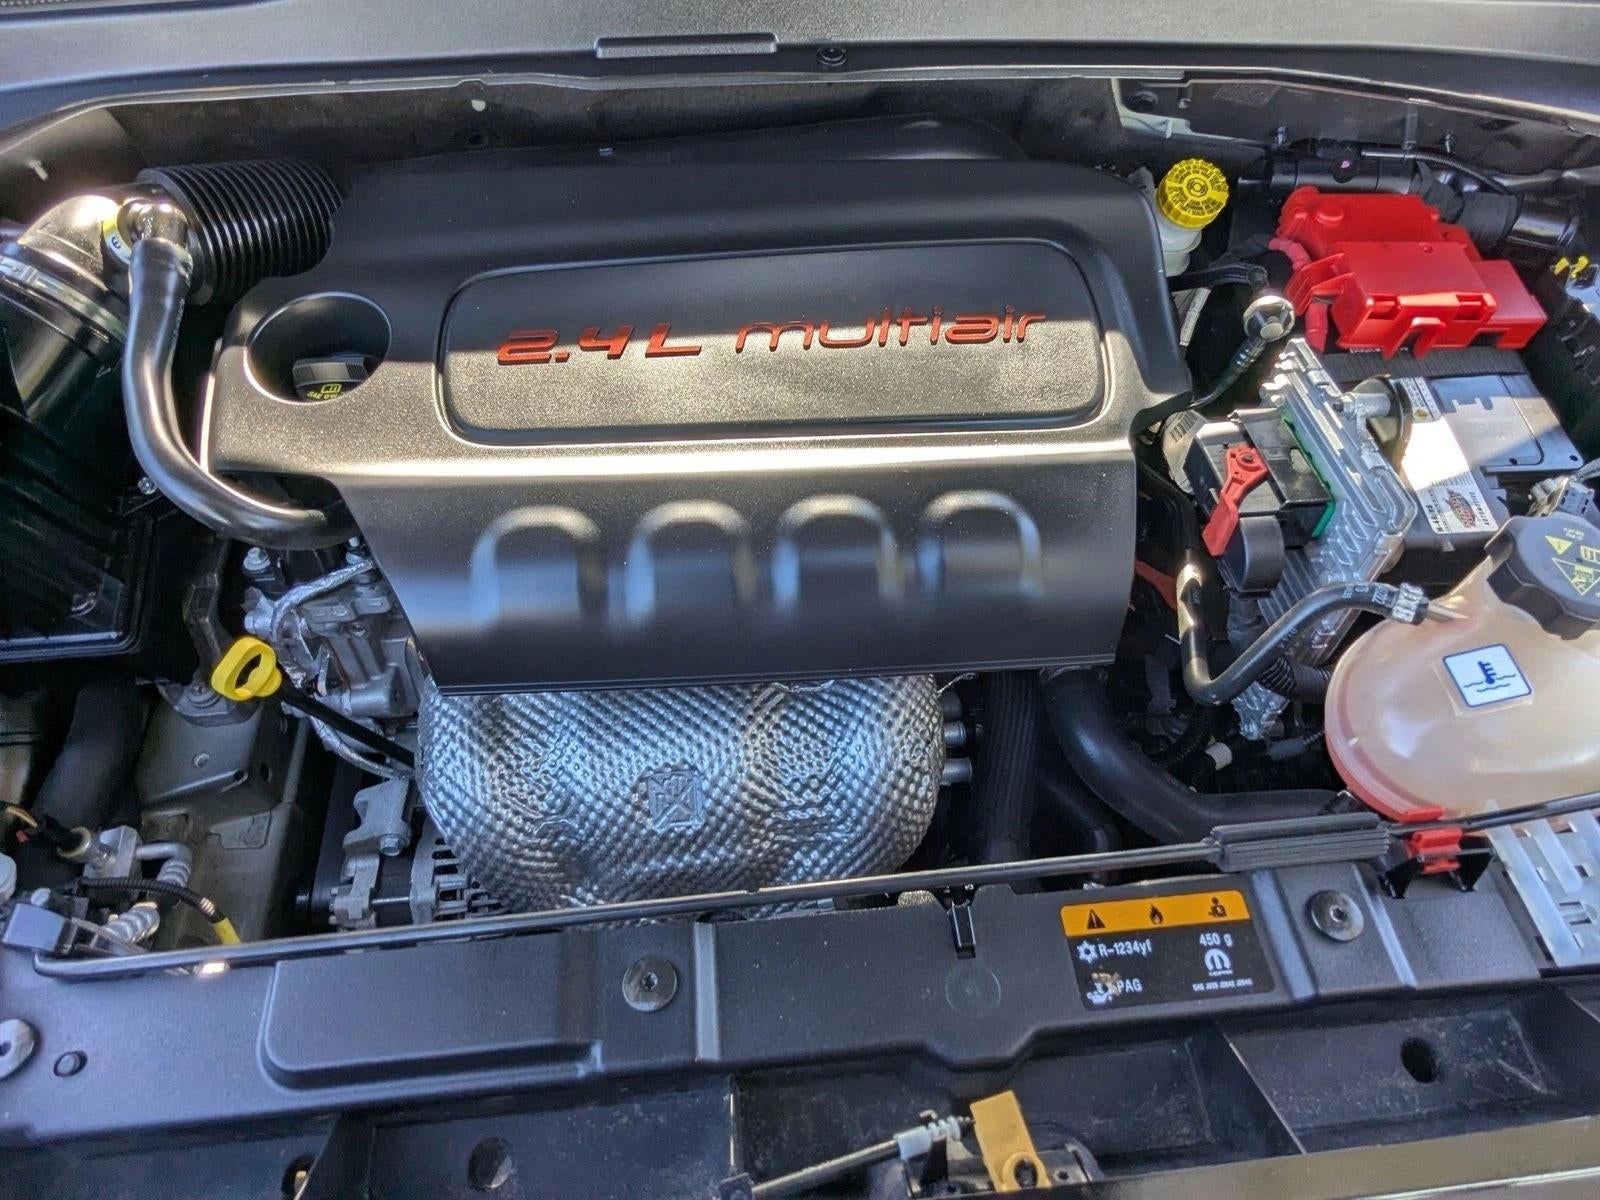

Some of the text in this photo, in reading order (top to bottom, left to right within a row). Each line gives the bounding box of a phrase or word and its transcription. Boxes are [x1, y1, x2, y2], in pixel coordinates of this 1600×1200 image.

[734, 304, 1047, 353] multiair
[306, 389, 323, 399] SAE
[1468, 491, 1491, 527] AUTOMOTIVE
[1098, 938, 1152, 958] R-1234yf
[1199, 932, 1233, 948] 450 g
[1117, 978, 1144, 994] PAG
